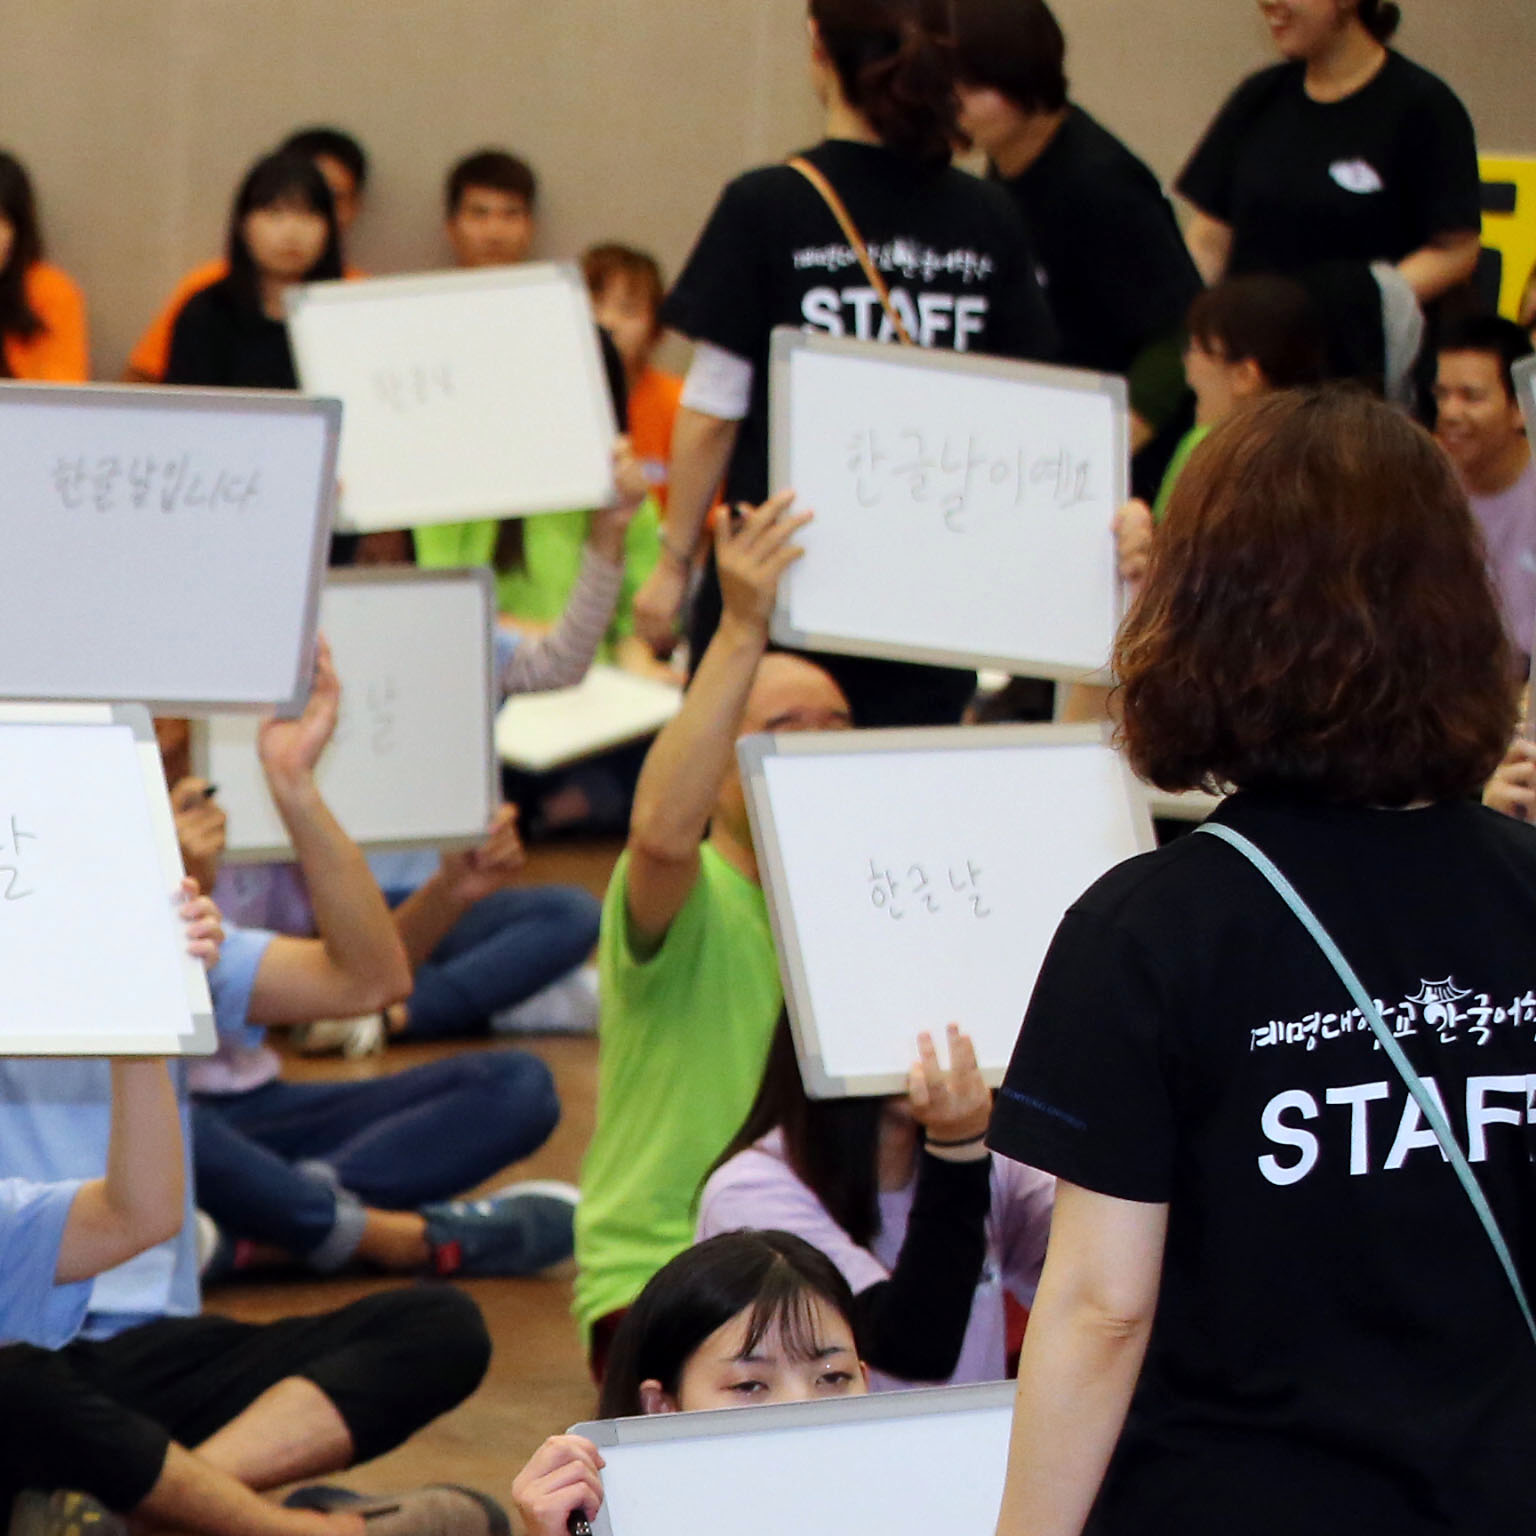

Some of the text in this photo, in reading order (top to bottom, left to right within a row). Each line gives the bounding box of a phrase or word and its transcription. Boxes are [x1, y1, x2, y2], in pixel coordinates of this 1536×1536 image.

[800, 286, 989, 352] STAFF
[50, 452, 262, 515] 한글날입니다
[866, 857, 993, 922] 한글날
